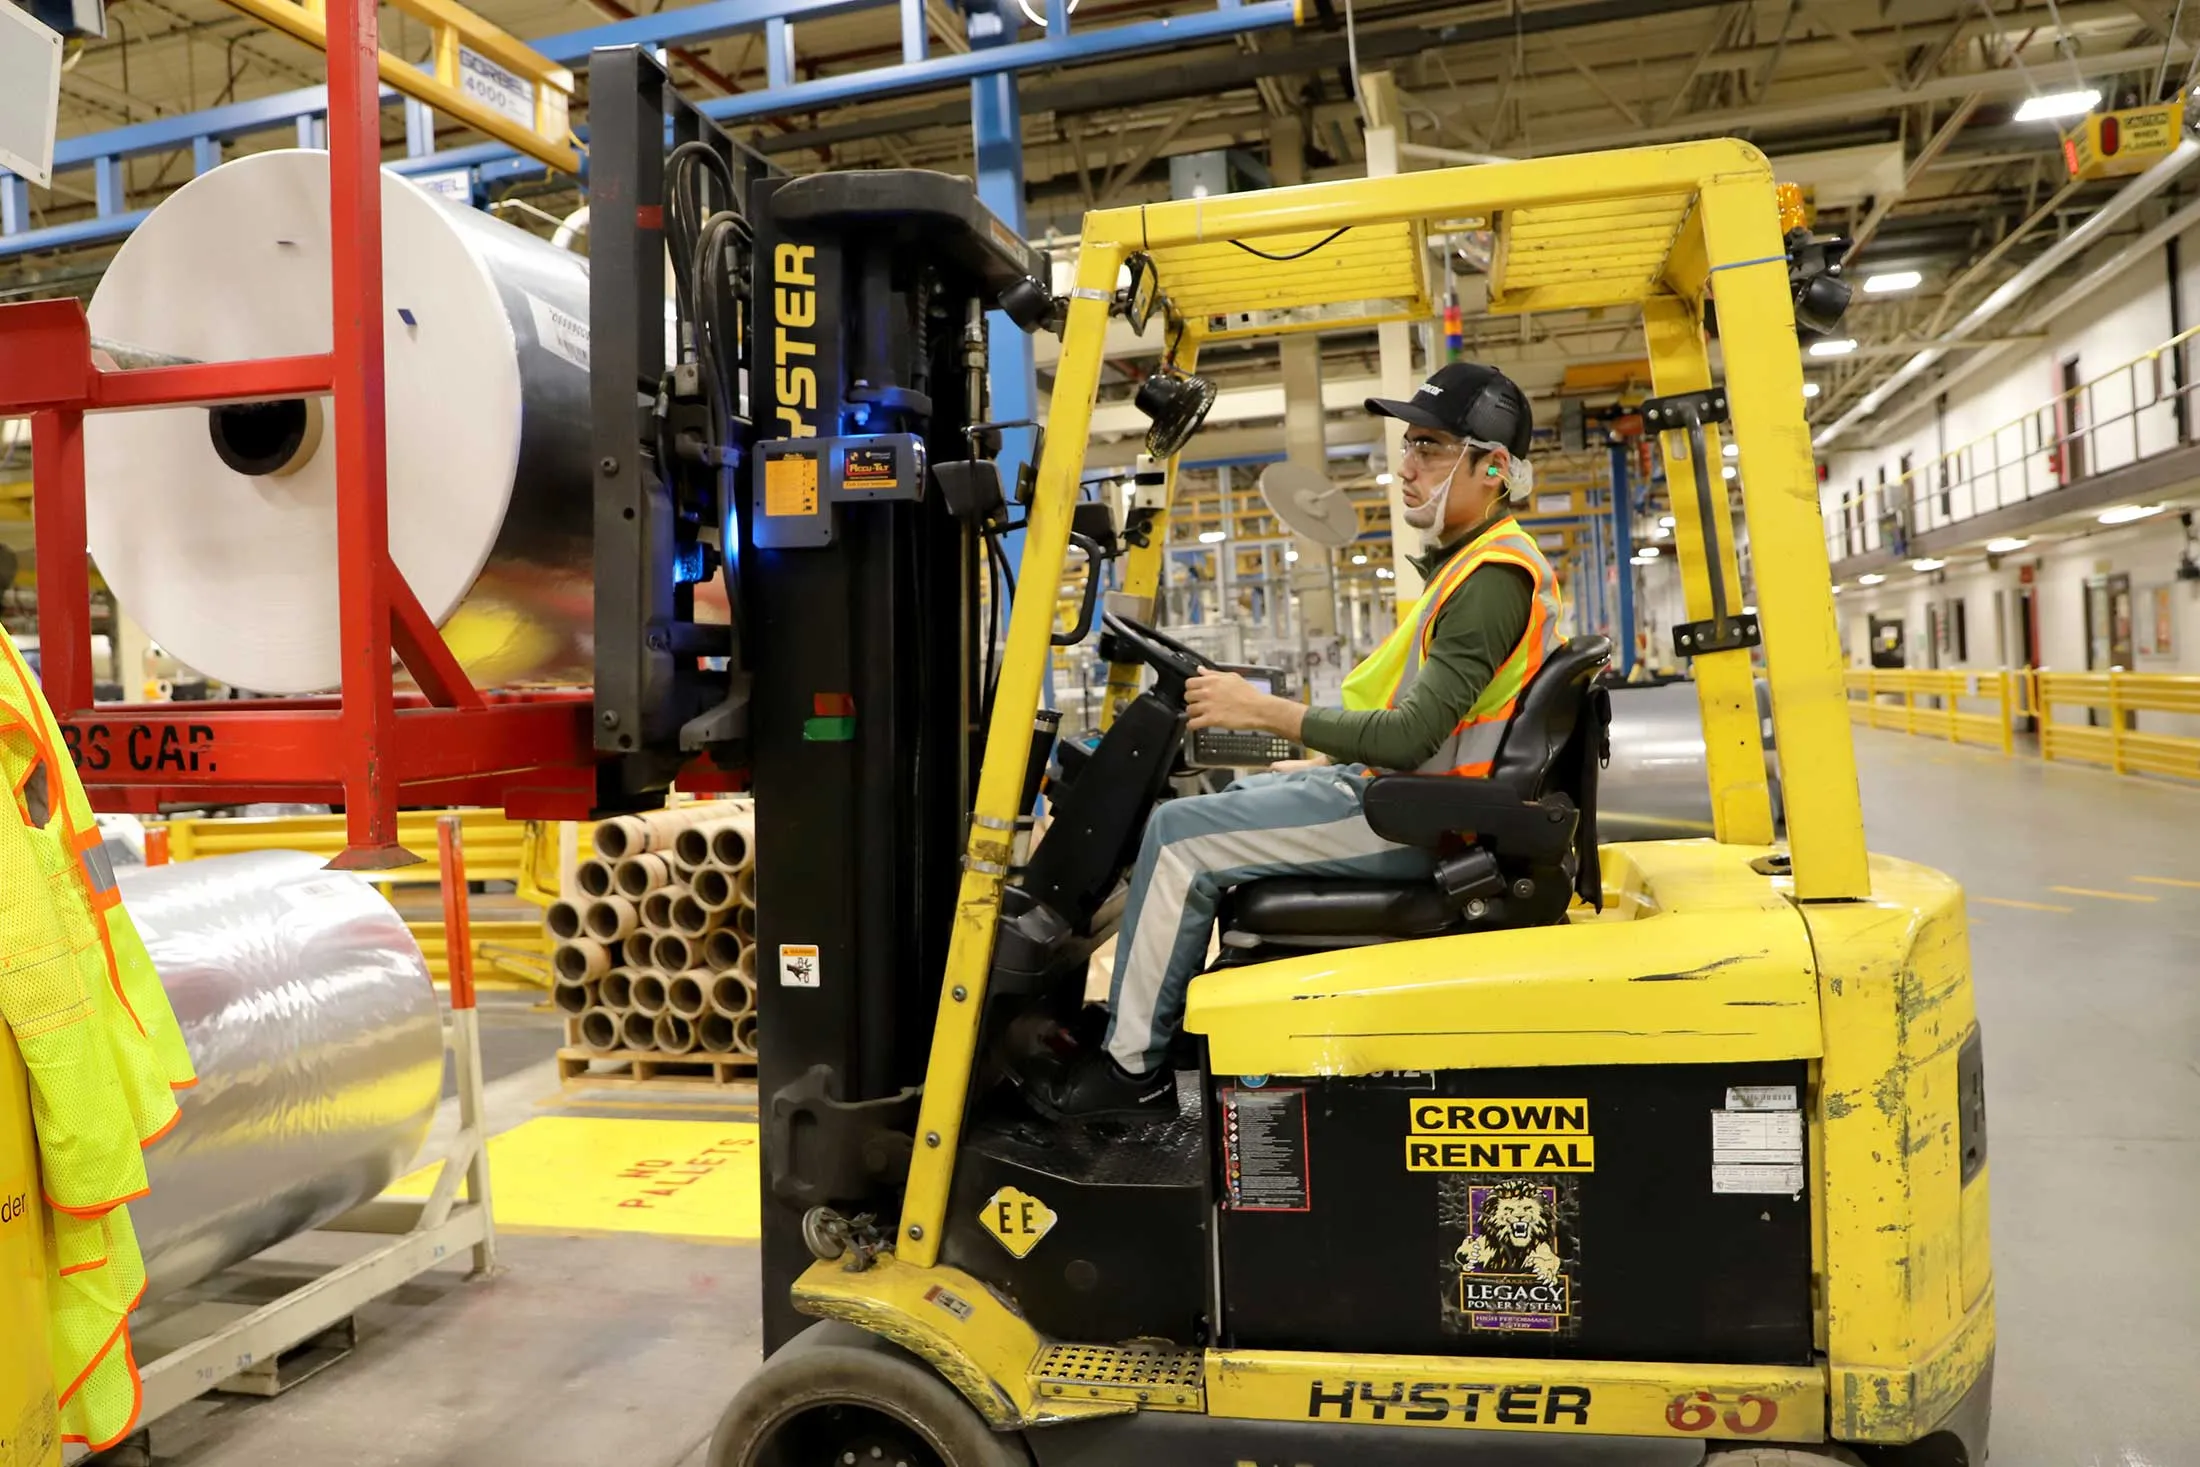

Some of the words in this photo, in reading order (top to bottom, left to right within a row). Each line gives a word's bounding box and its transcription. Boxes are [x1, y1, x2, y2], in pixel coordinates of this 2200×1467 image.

[465, 76, 507, 108] 4000
[774, 243, 817, 441] YSTER
[128, 725, 217, 772] CAP.
[1415, 1106, 1585, 1130] CROWN
[616, 1159, 674, 1178] NO
[1410, 1143, 1592, 1167] RENTAL
[616, 1138, 755, 1208] PALLETS
[1, 1193, 26, 1223] der
[1466, 1284, 1565, 1302] LEGACY
[1308, 1380, 1591, 1425] HYSTER
[1666, 1391, 1778, 1434] 60
